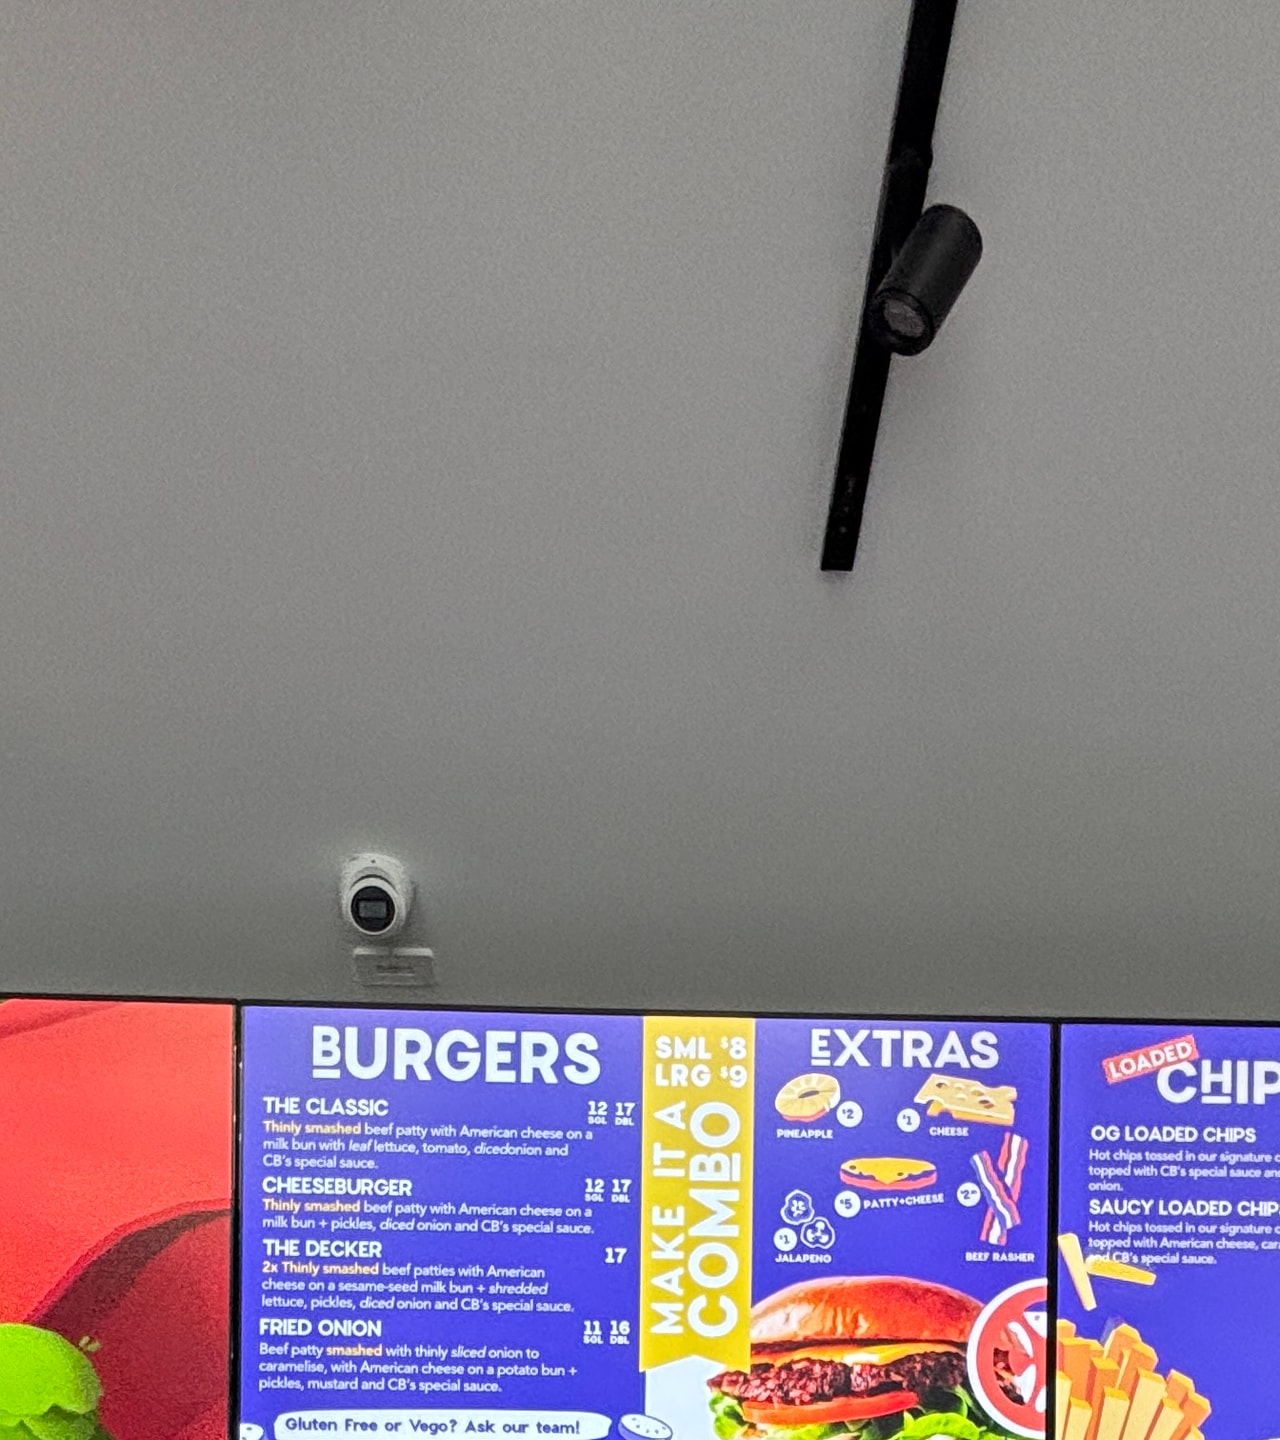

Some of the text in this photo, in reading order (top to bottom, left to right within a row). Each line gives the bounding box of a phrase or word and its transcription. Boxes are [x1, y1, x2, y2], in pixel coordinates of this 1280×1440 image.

[311, 1025, 602, 1085] BURGERS
[655, 1035, 747, 1060] SML $8
[810, 1028, 998, 1068] EXTRAS
[1108, 1040, 1193, 1079] LOADED
[654, 1063, 748, 1088] LRG $9
[262, 1096, 388, 1116] THE CLASSIC
[588, 1100, 635, 1116] 12 17
[262, 1119, 302, 1136] Thinly
[304, 1121, 362, 1135] smashed
[364, 1121, 394, 1135] beef
[395, 1125, 428, 1139] patty
[430, 1124, 456, 1136] with
[459, 1125, 517, 1138] American
[520, 1126, 563, 1139] cheese
[566, 1130, 582, 1139] on
[776, 1128, 833, 1138] PINEAPPLE
[928, 1126, 968, 1136] CHEESE
[1090, 1125, 1256, 1142] OG LOADED CHIPS
[262, 1136, 289, 1150] milk
[291, 1137, 316, 1150] bun
[318, 1138, 345, 1151] with
[348, 1138, 373, 1152] leaf
[373, 1139, 419, 1154] lettuce,
[421, 1142, 470, 1156] tomato,
[544, 1143, 568, 1156] and
[1088, 1148, 1110, 1160] Hot
[262, 1153, 378, 1169] CB's special sauce.
[1159, 1165, 1186, 1177] CB's
[261, 1176, 412, 1195] CHEESEBURGER
[585, 1178, 632, 1193] 12 17
[1089, 1198, 1154, 1215] SAUCY
[1158, 1199, 1232, 1216] LOADED
[262, 1215, 288, 1228] milk
[290, 1215, 315, 1228] bun
[330, 1216, 376, 1232] pickles,
[379, 1217, 415, 1230] diced
[416, 1219, 452, 1231] onion
[454, 1219, 478, 1232] and
[480, 1219, 509, 1232] CB's
[511, 1221, 553, 1235] special
[556, 1224, 594, 1234] sauce.
[651, 1101, 687, 1335] MAKE IT A
[687, 1101, 741, 1338] COMBO
[262, 1238, 382, 1257] THE DECKER
[604, 1247, 627, 1263] 17
[965, 1251, 1034, 1262] BEEF RASHER
[774, 1253, 832, 1263] JALAPENO
[262, 1260, 545, 1278] 2x Thinly smashed beef patties with American
[259, 1318, 382, 1336] FRIED ONION
[583, 1320, 630, 1334] 11 16
[259, 1342, 539, 1361] Beef patty smashed with thinly sliced onion to
[258, 1376, 502, 1393] pickles, mustard and CB's special sauce.
[284, 1417, 579, 1435] Gluten Free or Vego? Ask our team!
